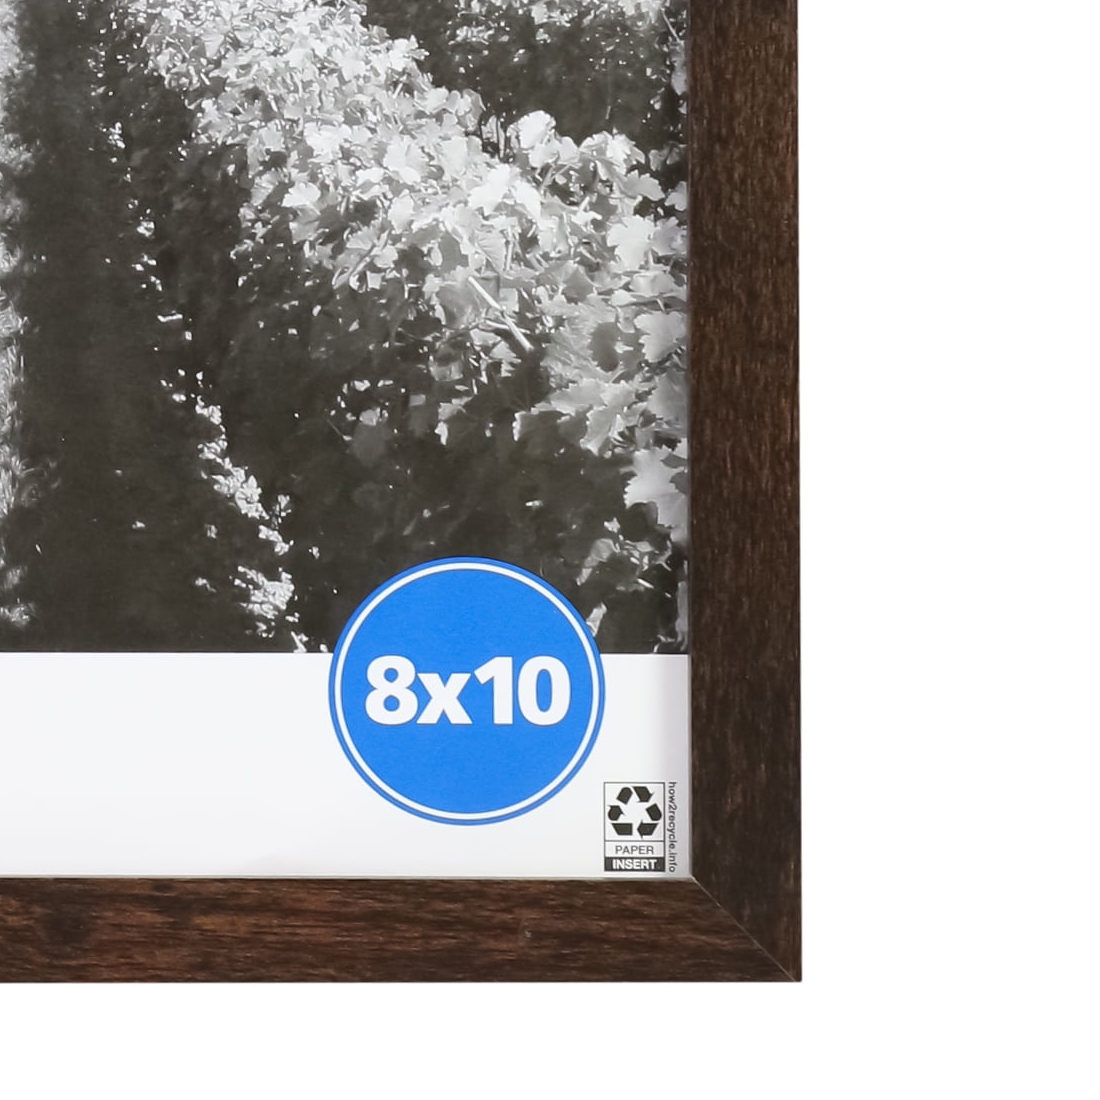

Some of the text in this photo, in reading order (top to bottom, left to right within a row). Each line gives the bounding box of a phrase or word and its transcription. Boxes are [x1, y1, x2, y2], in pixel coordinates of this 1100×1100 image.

[365, 655, 571, 726] 8x10
[667, 781, 678, 873] how2recycle.info
[612, 859, 657, 870] INSERT
[615, 845, 654, 855] PAPER
